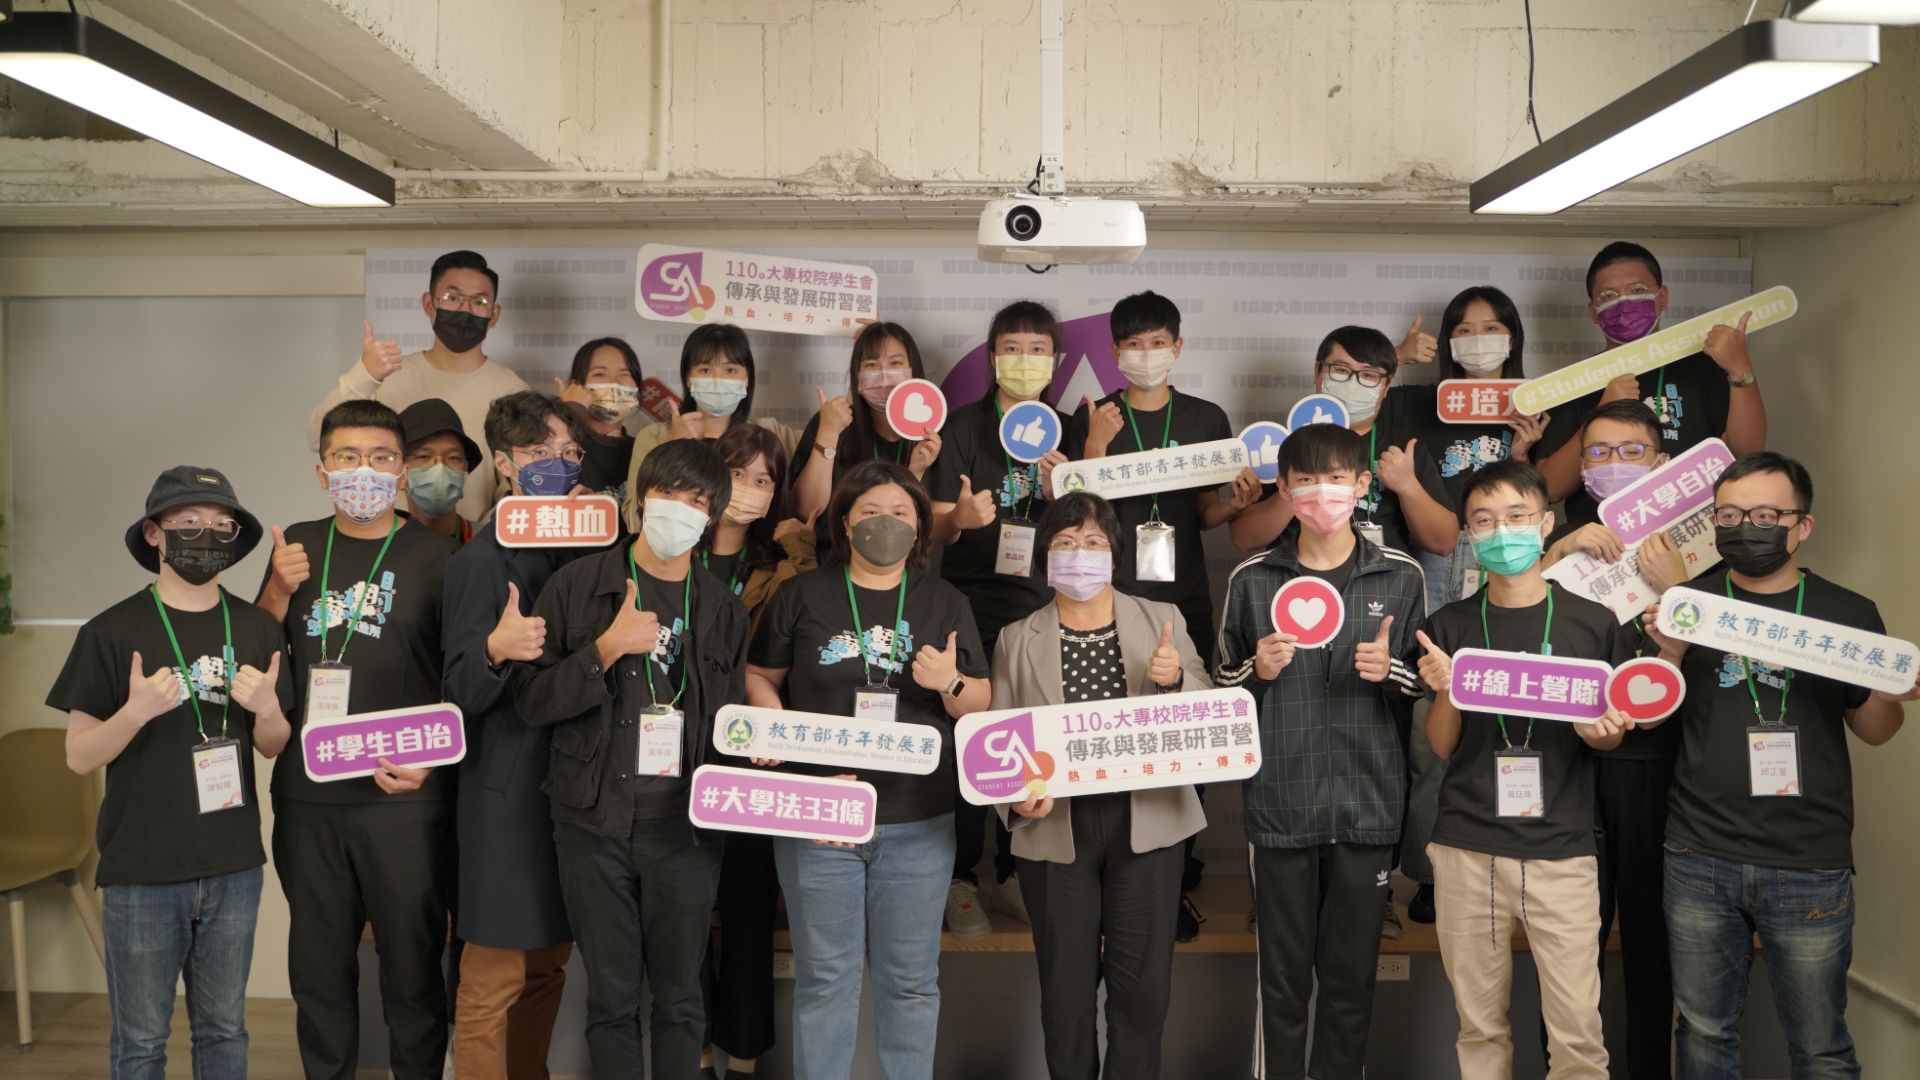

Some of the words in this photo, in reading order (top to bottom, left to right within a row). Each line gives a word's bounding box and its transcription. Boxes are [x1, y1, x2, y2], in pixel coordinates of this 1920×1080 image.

[725, 281, 873, 313] 傳承與發展研習營
[1097, 448, 1244, 483] 教育部青年發展署
[1617, 457, 1727, 531] #大學自治
[507, 505, 608, 538] #熱血
[1716, 610, 1913, 674] 教育部青年發展署
[1462, 669, 1600, 706] #線上營隊
[316, 722, 452, 763] #學生自治
[768, 721, 936, 756] 教育部青年發展署
[1065, 722, 1253, 763] 傳承與發展研習營
[701, 786, 867, 826] #大學法33條
